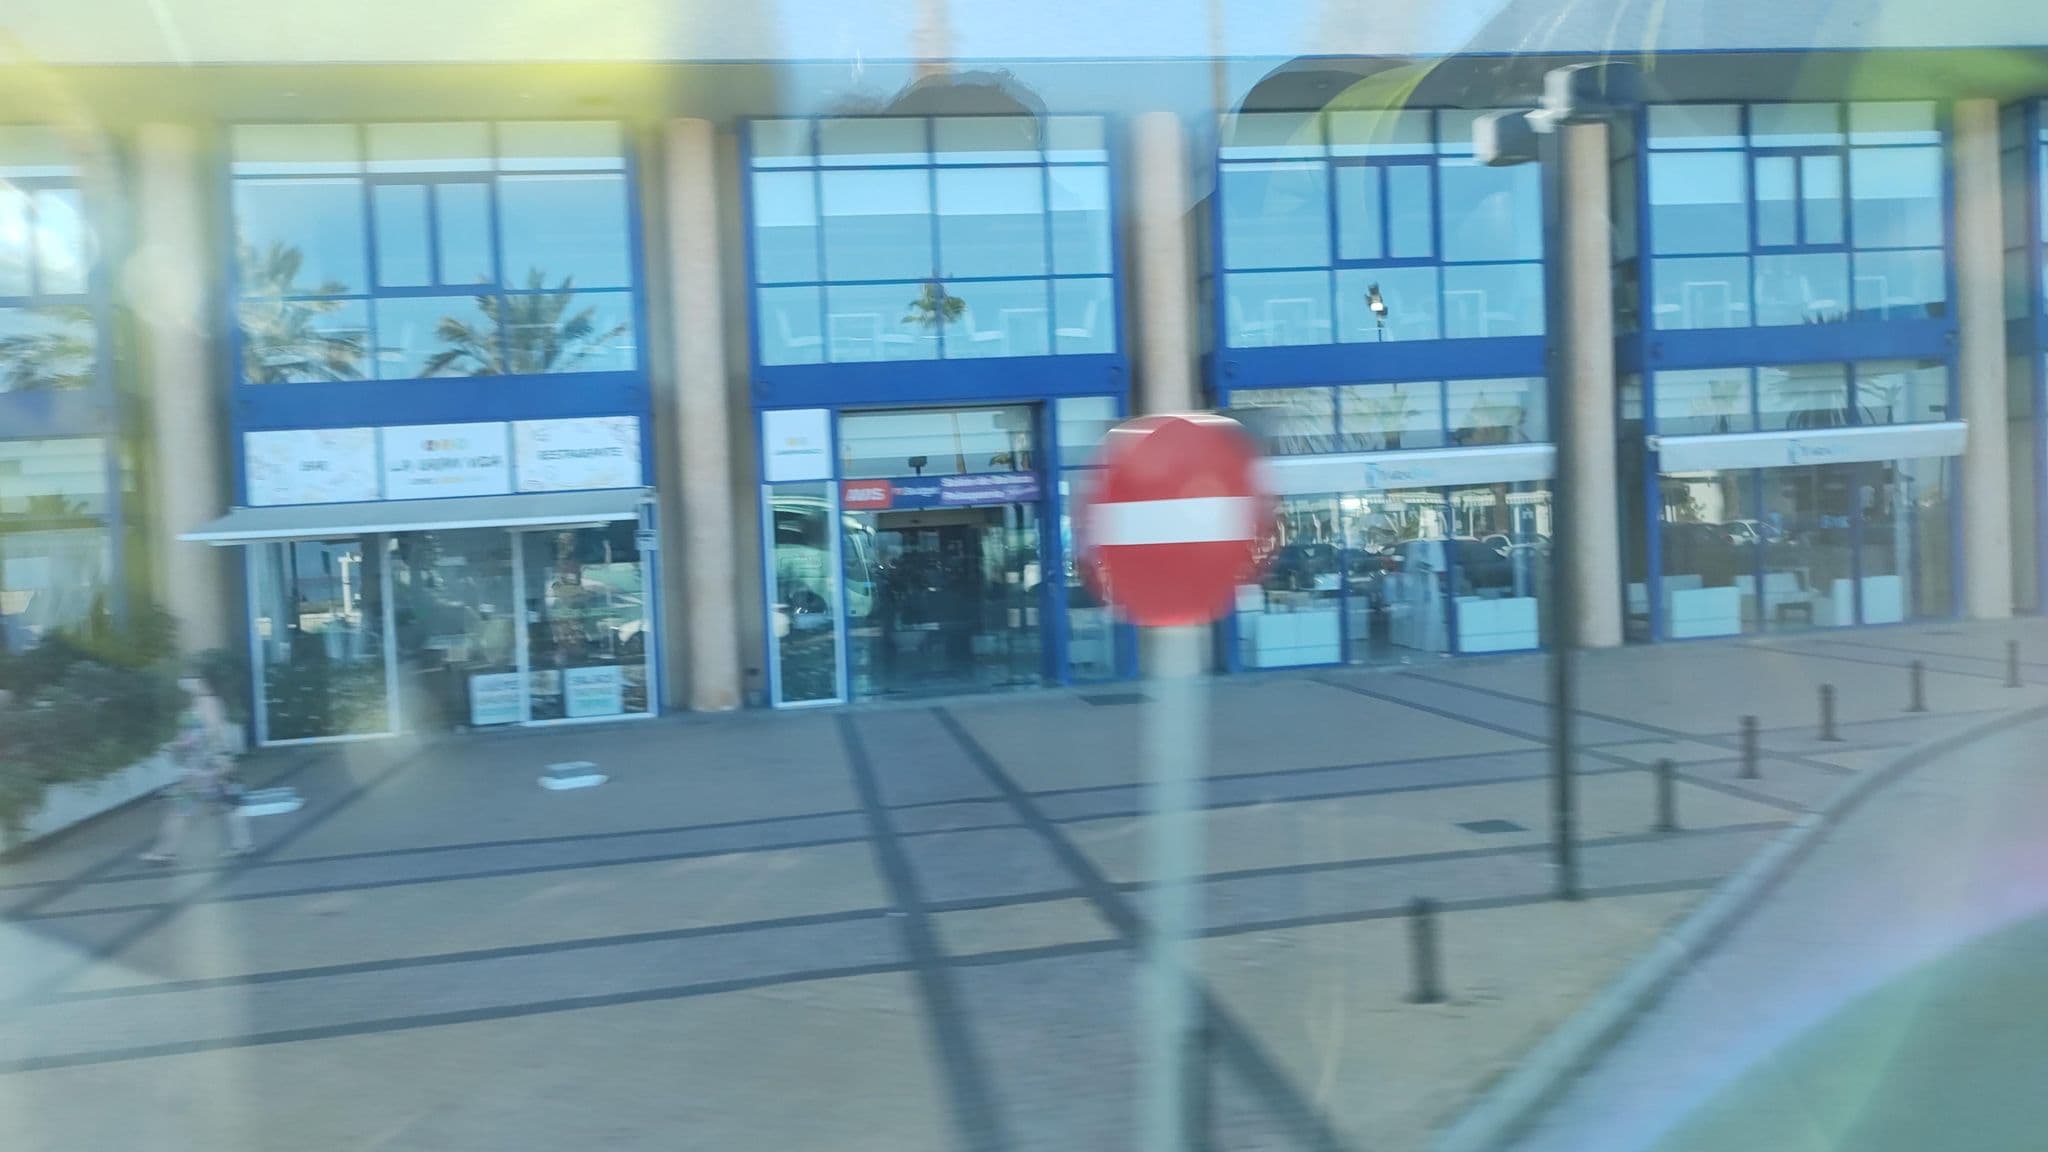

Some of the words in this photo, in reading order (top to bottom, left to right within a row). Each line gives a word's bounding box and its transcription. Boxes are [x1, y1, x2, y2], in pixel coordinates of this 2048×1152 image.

[538, 446, 622, 461] RESTAURANTE
[391, 458, 411, 472] LA
[465, 455, 502, 468] VIDA
